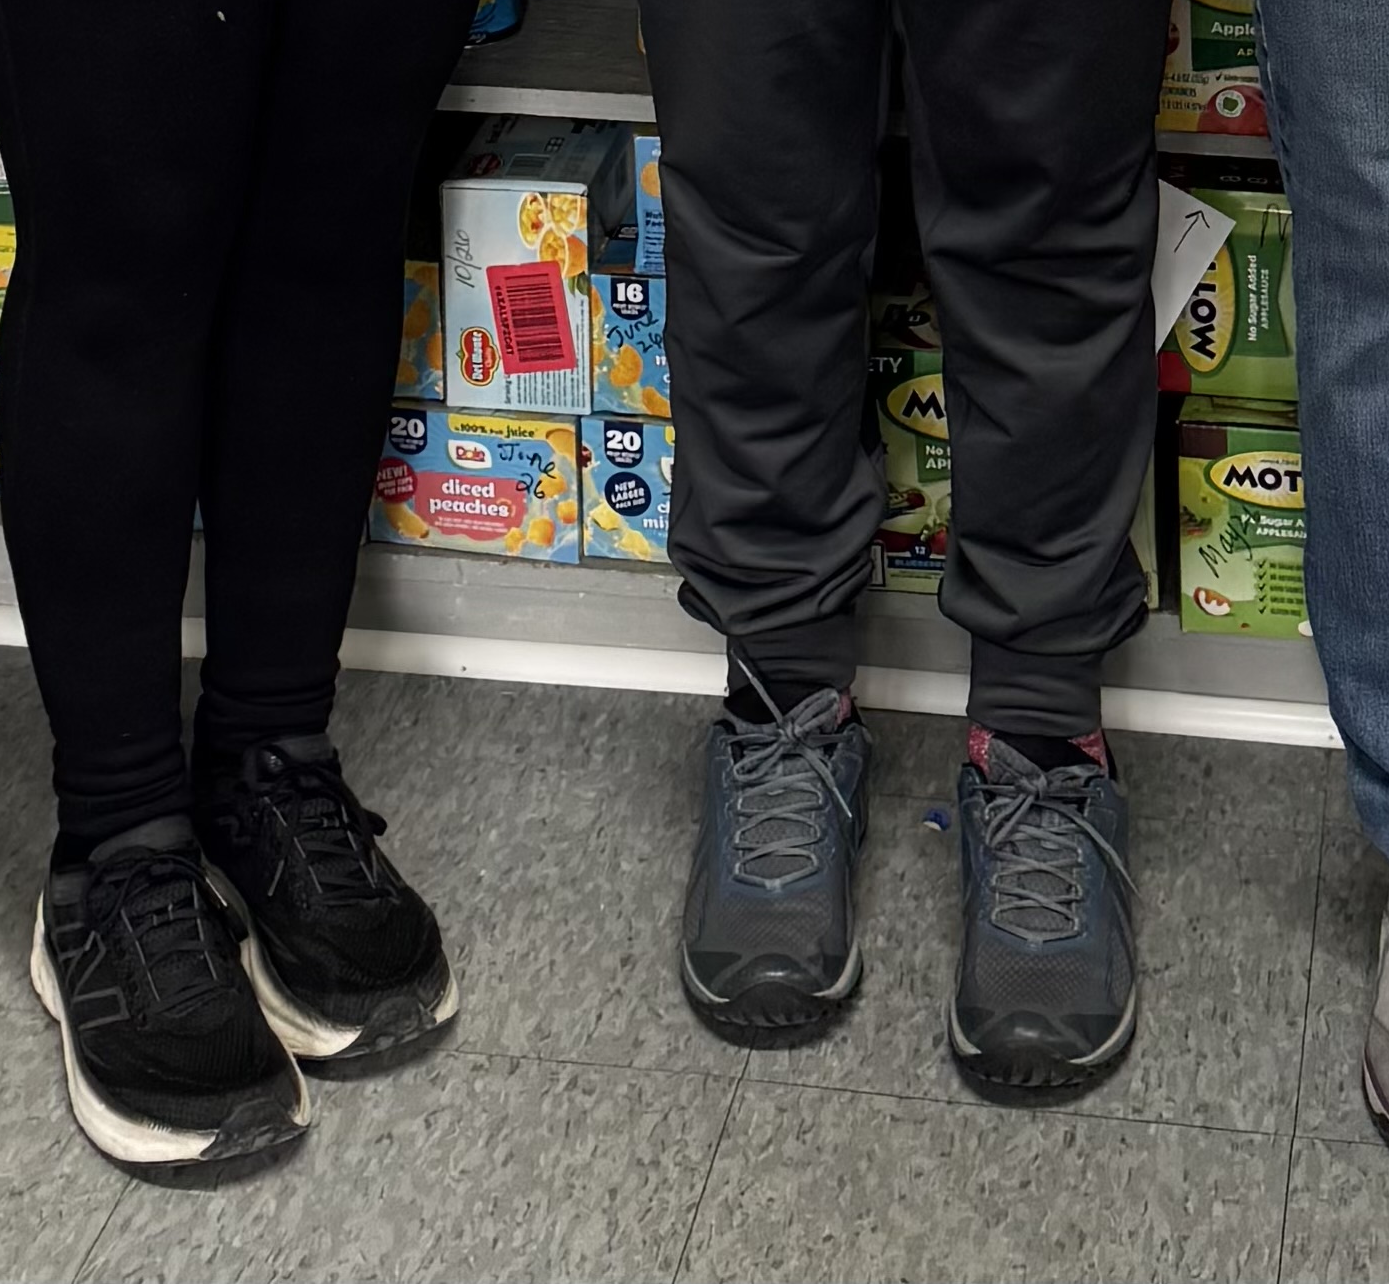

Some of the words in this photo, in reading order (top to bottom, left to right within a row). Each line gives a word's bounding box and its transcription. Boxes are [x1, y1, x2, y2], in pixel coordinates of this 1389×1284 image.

[615, 281, 644, 304] 16
[390, 416, 425, 438] 20
[605, 430, 641, 451] 20
[441, 479, 495, 496] diced
[429, 497, 510, 517] peaches
